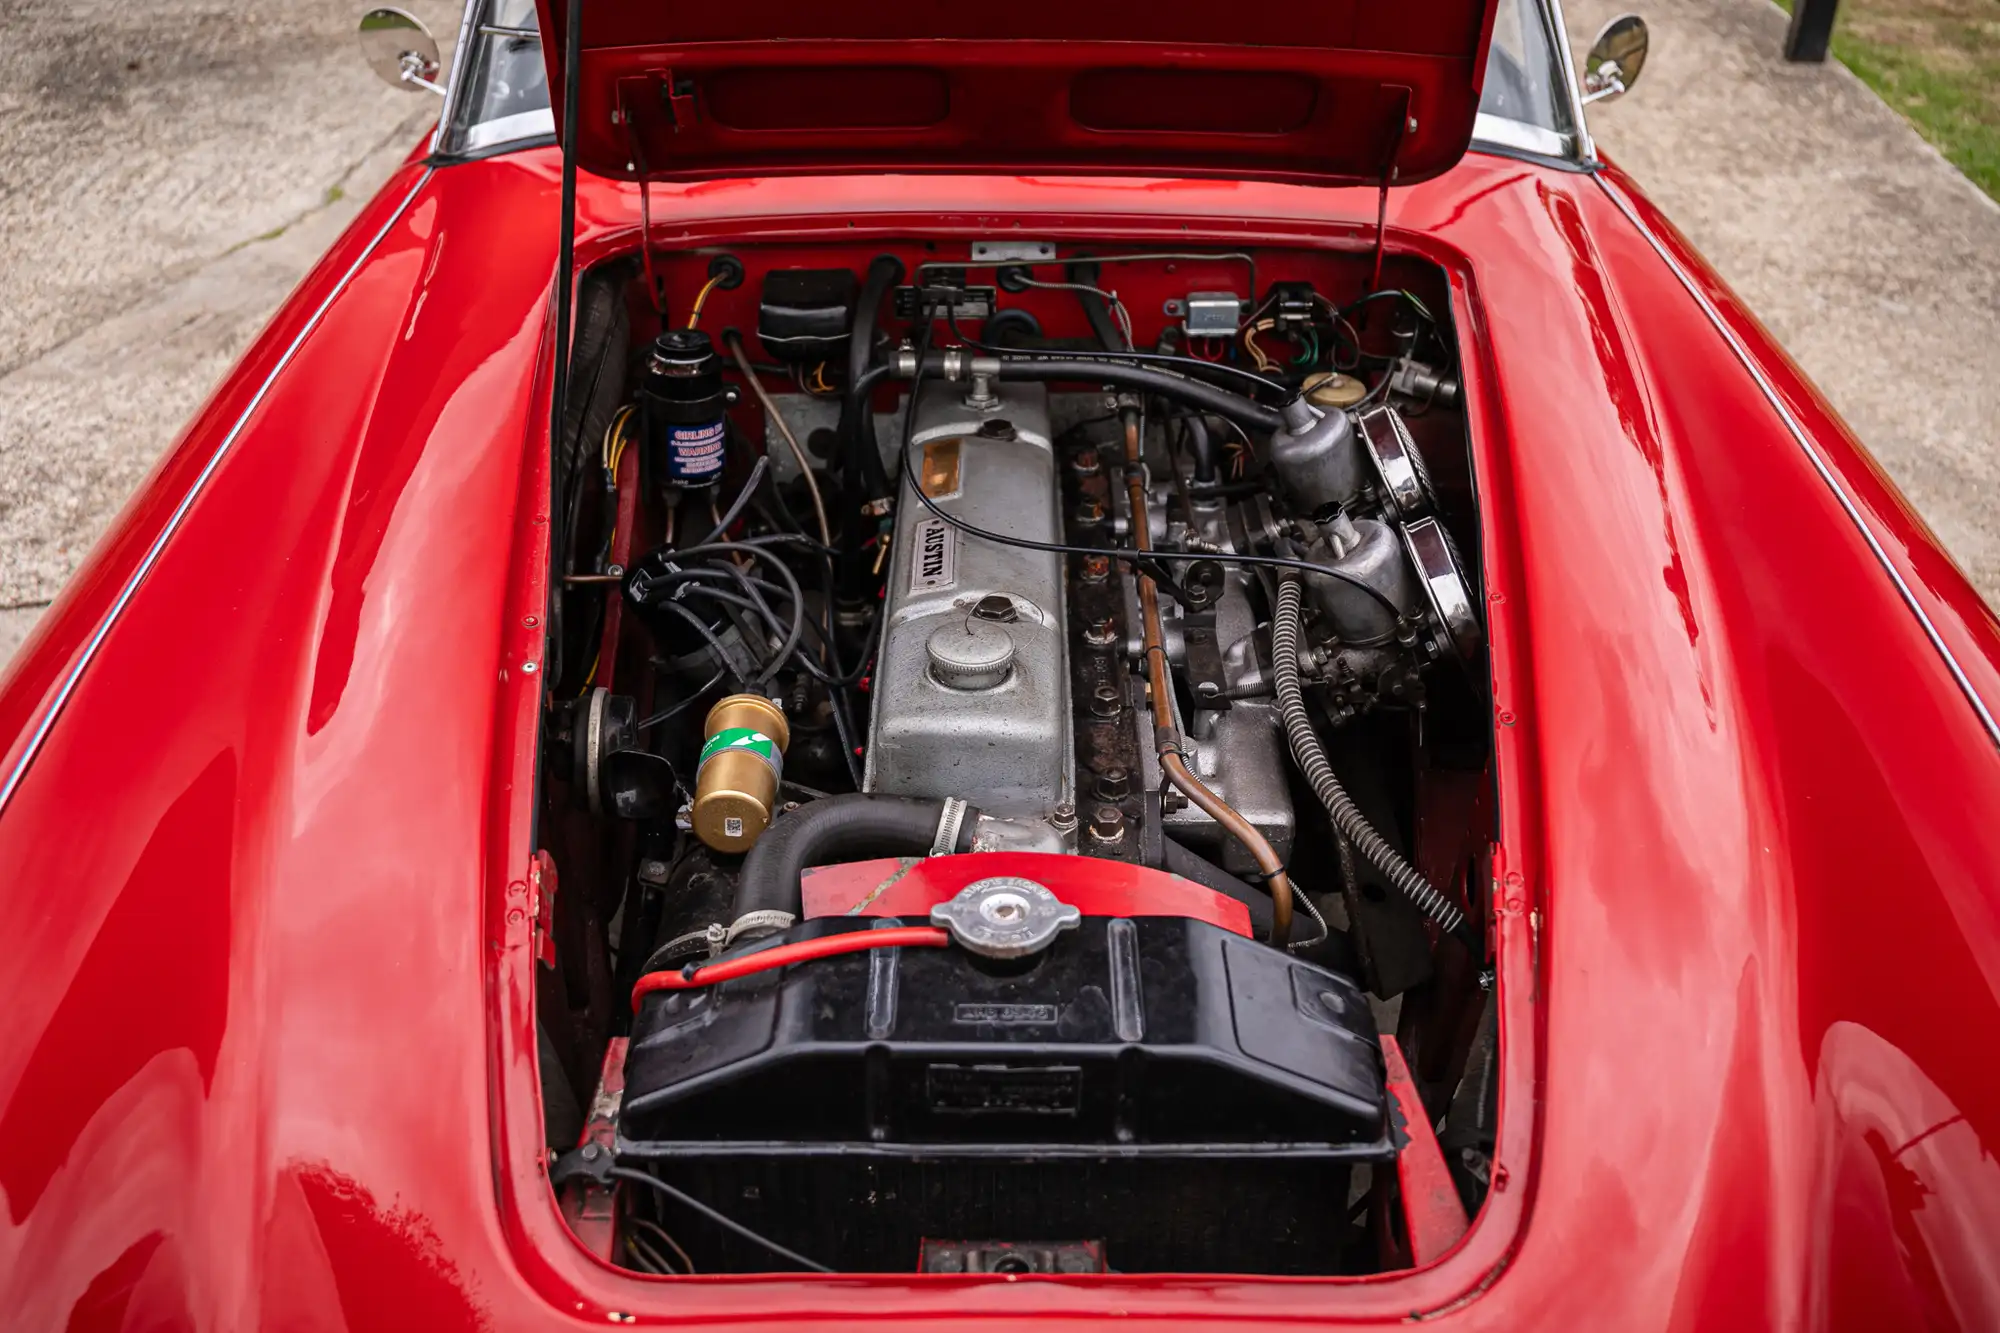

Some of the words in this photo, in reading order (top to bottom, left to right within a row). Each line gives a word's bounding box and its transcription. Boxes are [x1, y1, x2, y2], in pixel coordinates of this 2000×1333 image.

[675, 427, 715, 440] GIRLING
[678, 441, 722, 456] WARNING
[923, 527, 945, 577] AUSTIN
